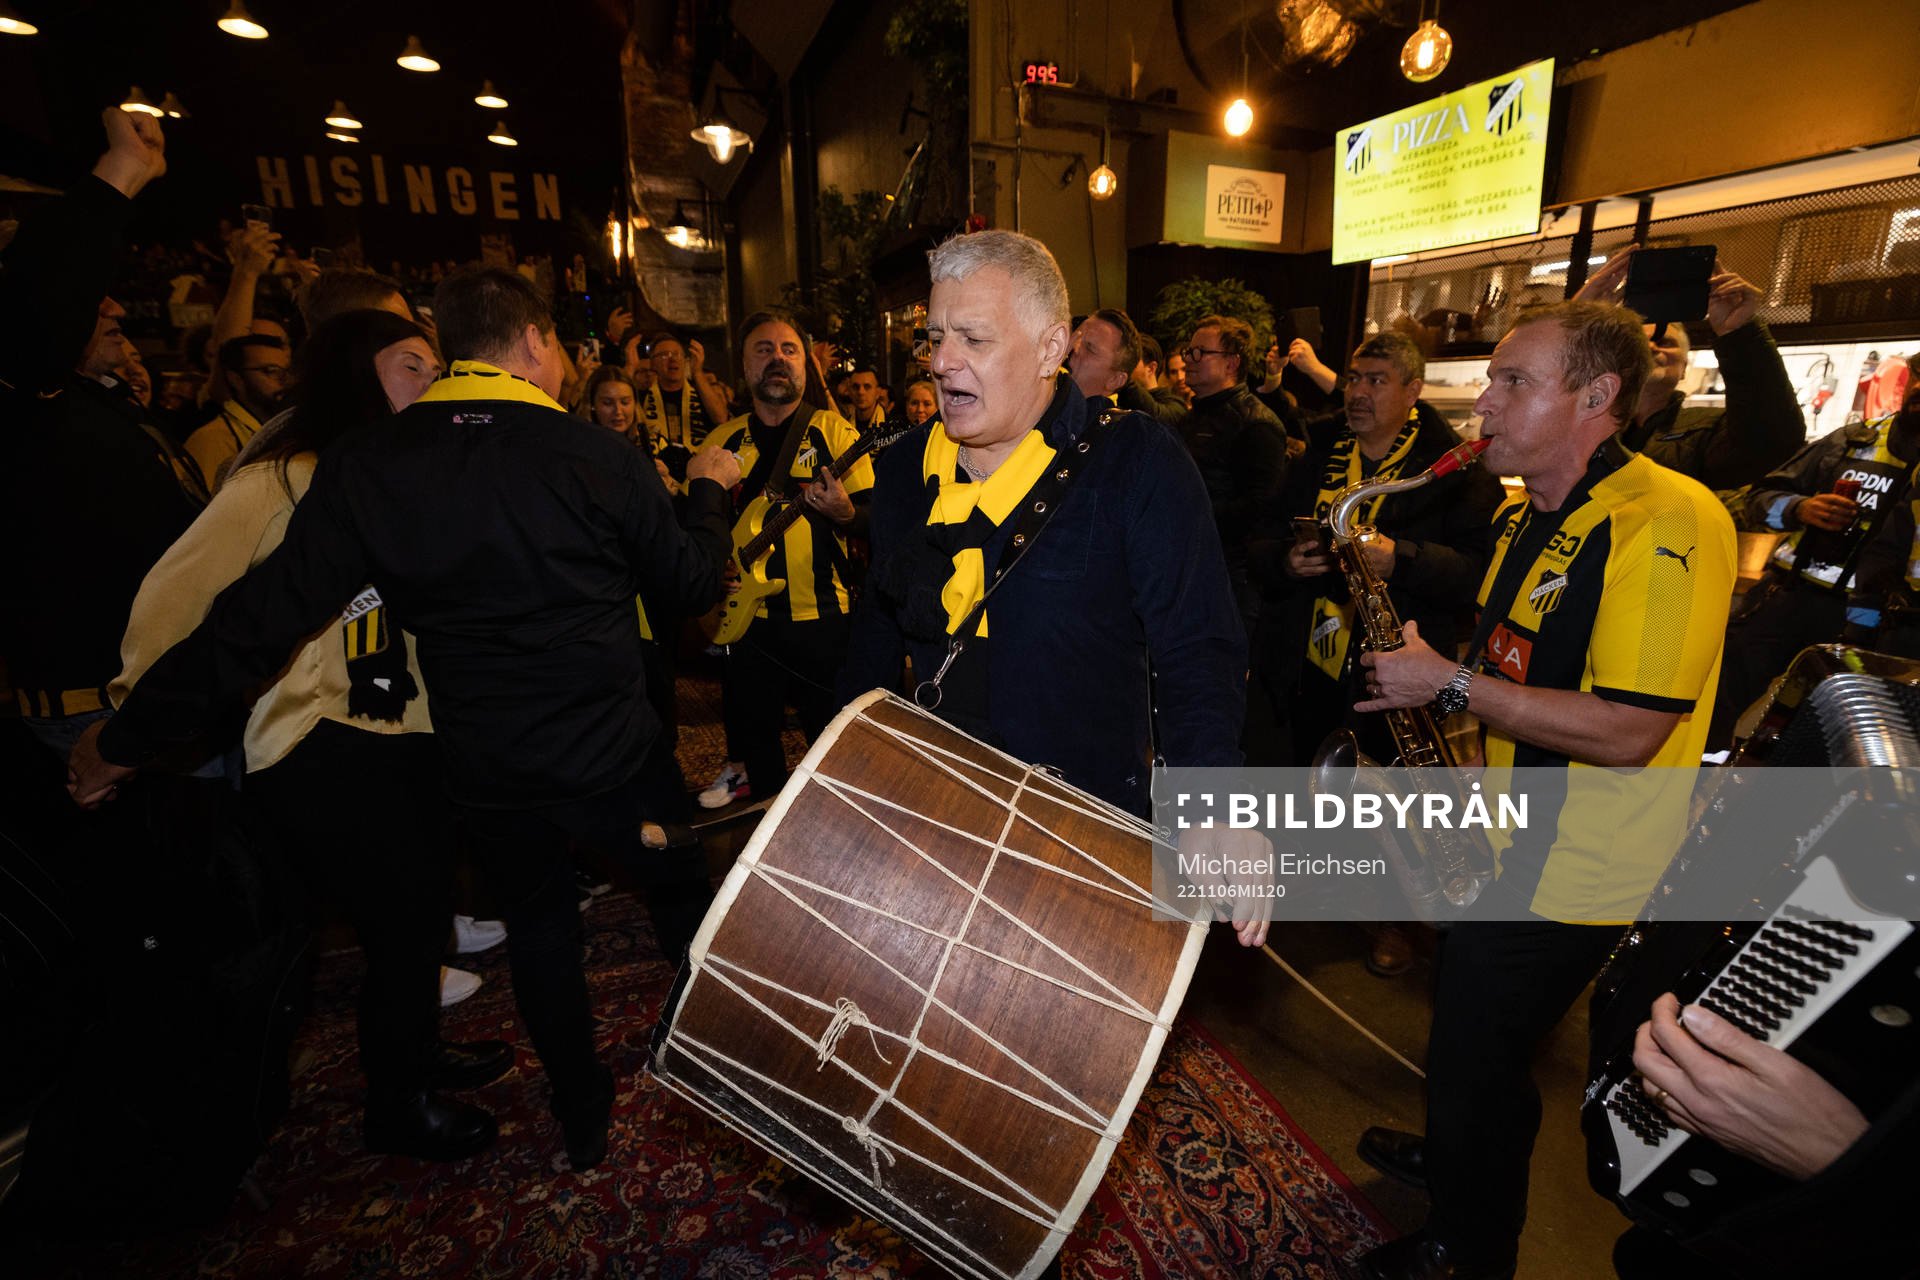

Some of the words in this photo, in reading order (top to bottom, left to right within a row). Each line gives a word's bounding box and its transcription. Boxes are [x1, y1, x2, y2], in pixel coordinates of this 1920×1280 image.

[1026, 65, 1058, 84] 995
[1393, 103, 1470, 153] PIZZA
[1402, 140, 1458, 161] KEBABPIZZA
[1391, 155, 1448, 176] MOZZARELLA
[256, 153, 562, 220] HISINGEN
[1408, 180, 1447, 194] POMMES
[343, 593, 381, 620] KEN
